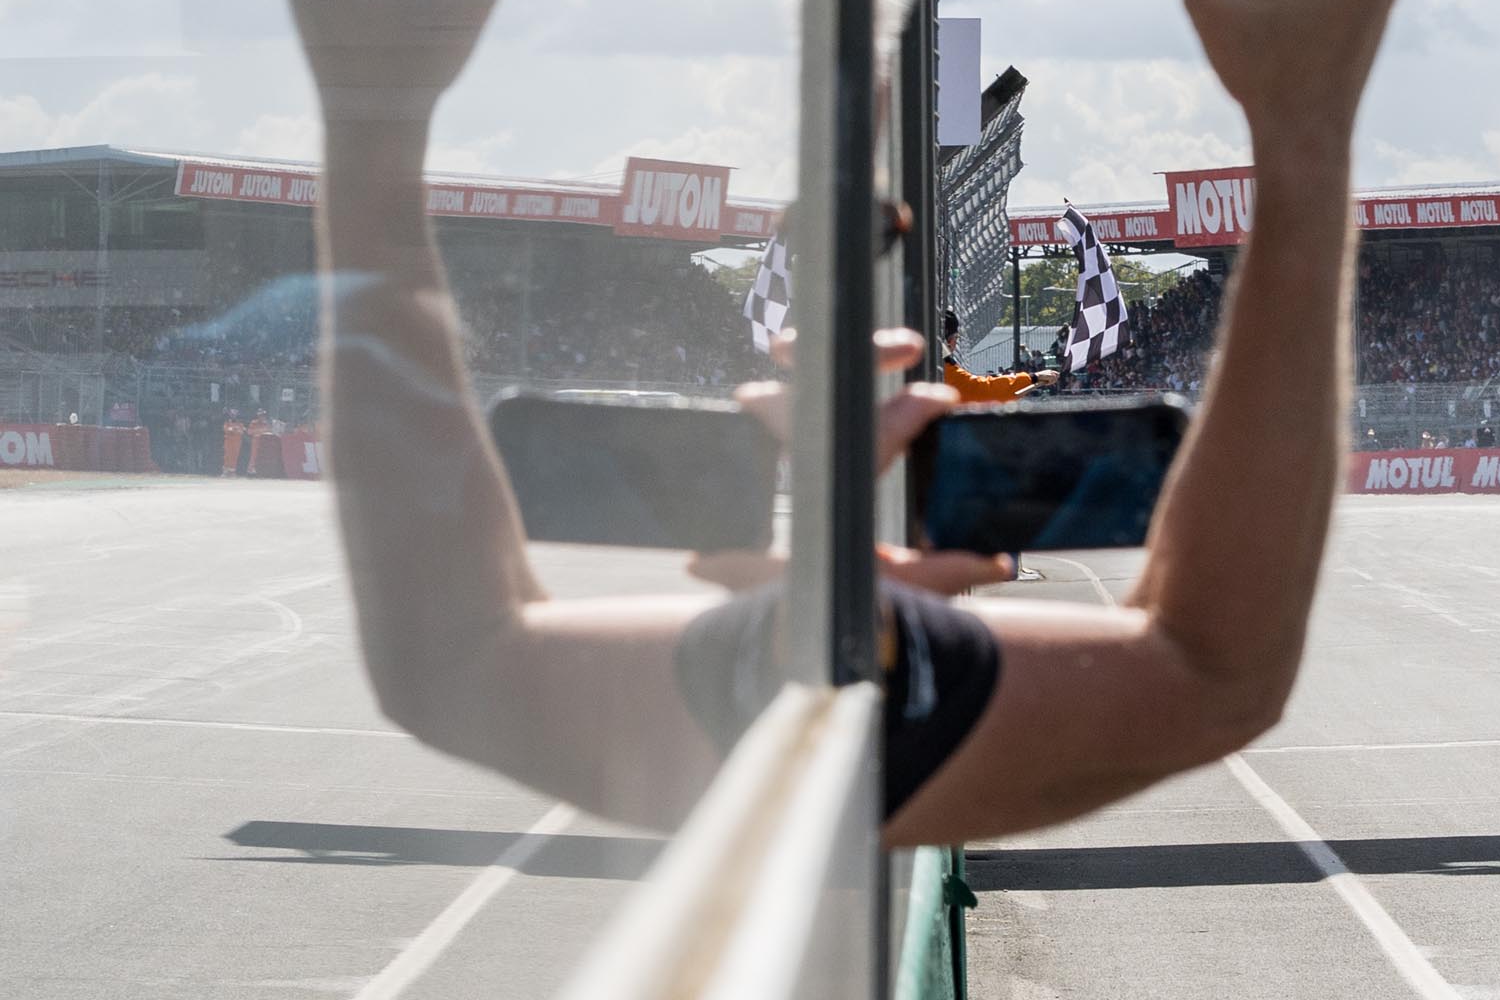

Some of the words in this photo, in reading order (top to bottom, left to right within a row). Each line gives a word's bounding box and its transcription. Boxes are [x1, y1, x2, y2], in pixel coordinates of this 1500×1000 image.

[1176, 178, 1254, 235] MOTU
[1374, 203, 1412, 225] MOTUL
[1417, 201, 1455, 223] MOTUL
[1460, 200, 1498, 222] MOTUL
[1018, 222, 1049, 242] MOTUL
[1125, 216, 1158, 237] MOTUL
[1365, 456, 1455, 489] MOTUL
